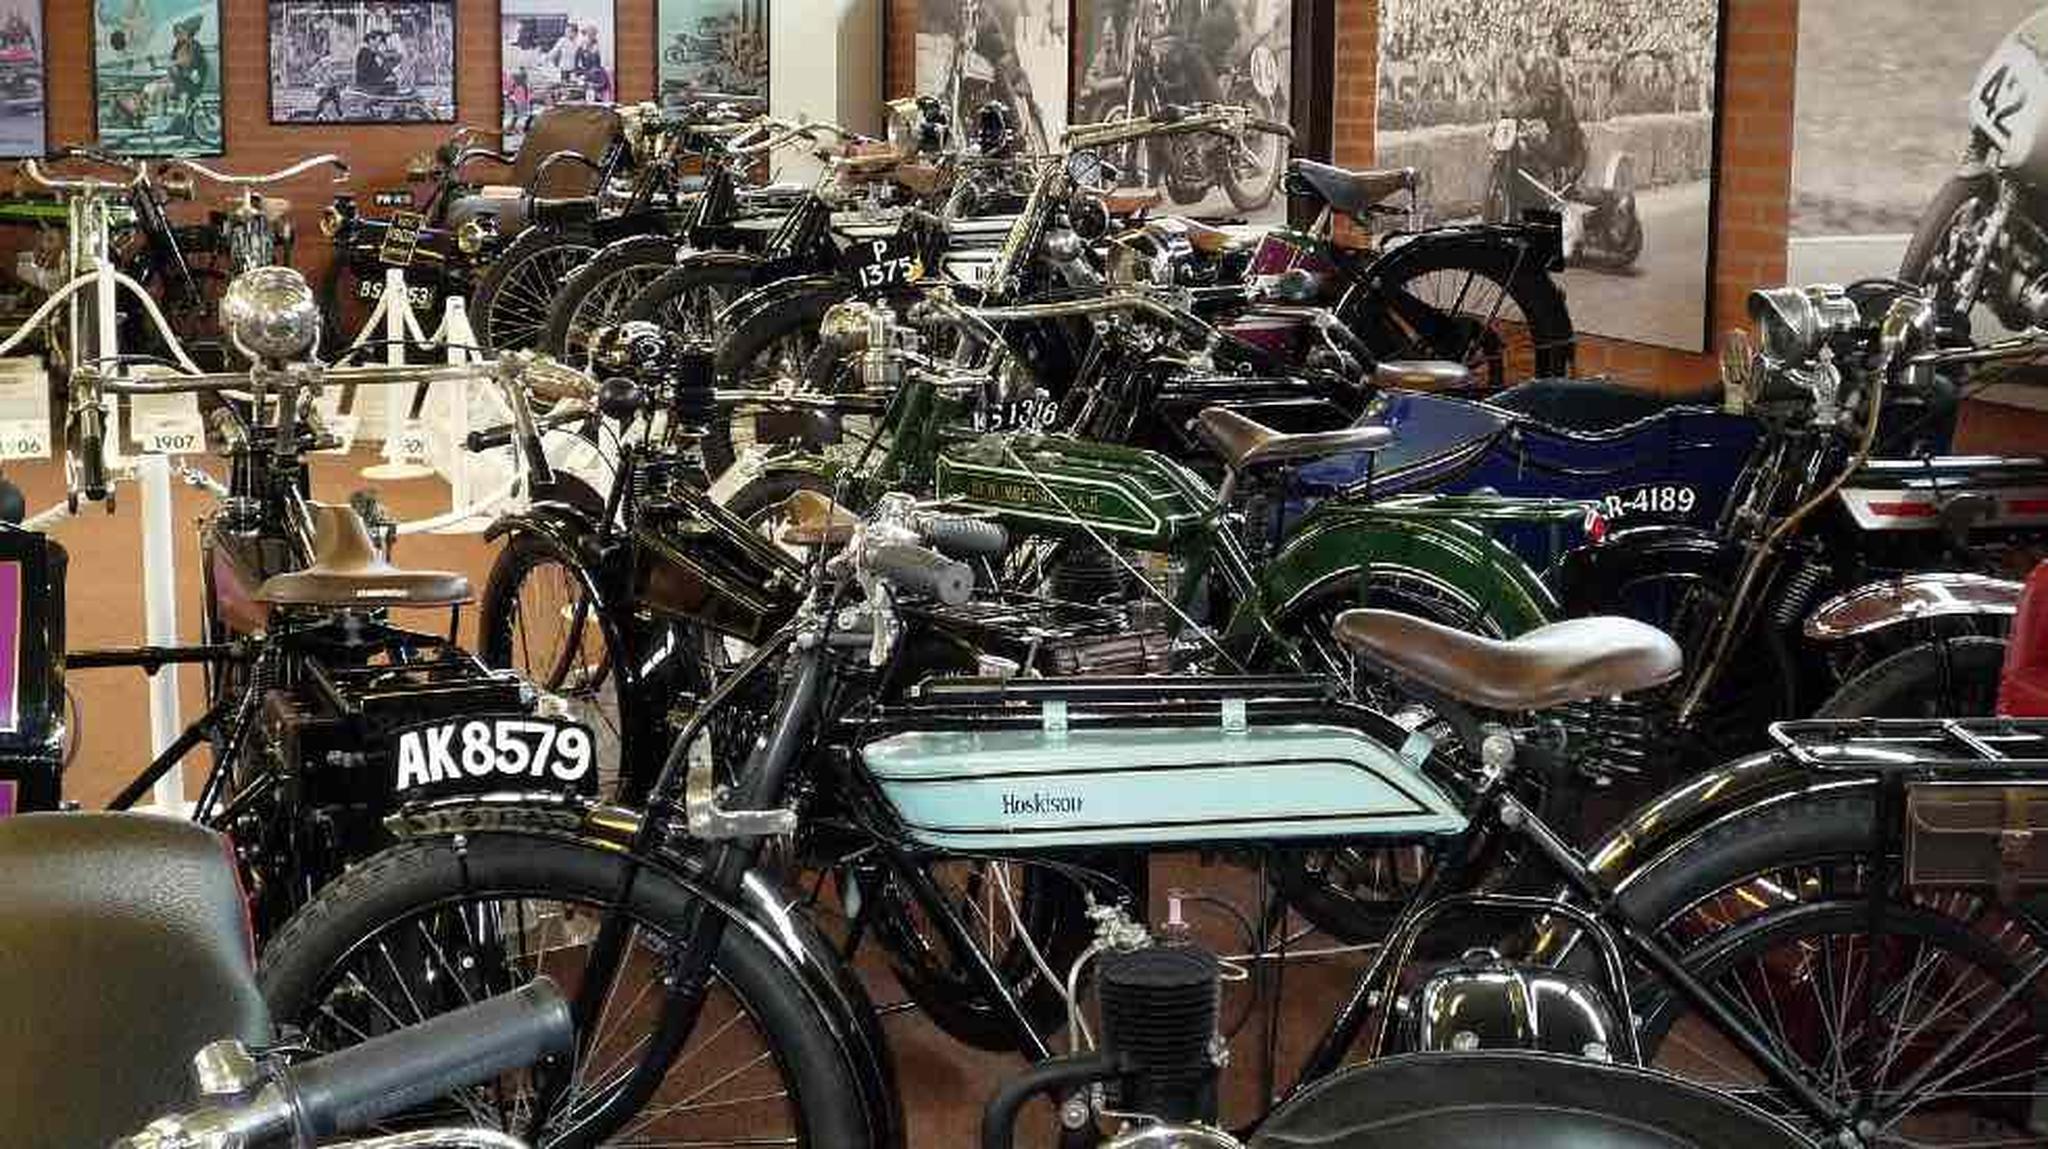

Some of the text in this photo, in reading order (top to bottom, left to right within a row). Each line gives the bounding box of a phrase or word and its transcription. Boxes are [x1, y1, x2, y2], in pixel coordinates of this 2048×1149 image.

[1979, 65, 2028, 138] 42
[872, 239, 887, 262] P
[859, 255, 915, 288] 1375
[154, 434, 196, 450] 1907
[1001, 792, 1085, 814] Hoskison
